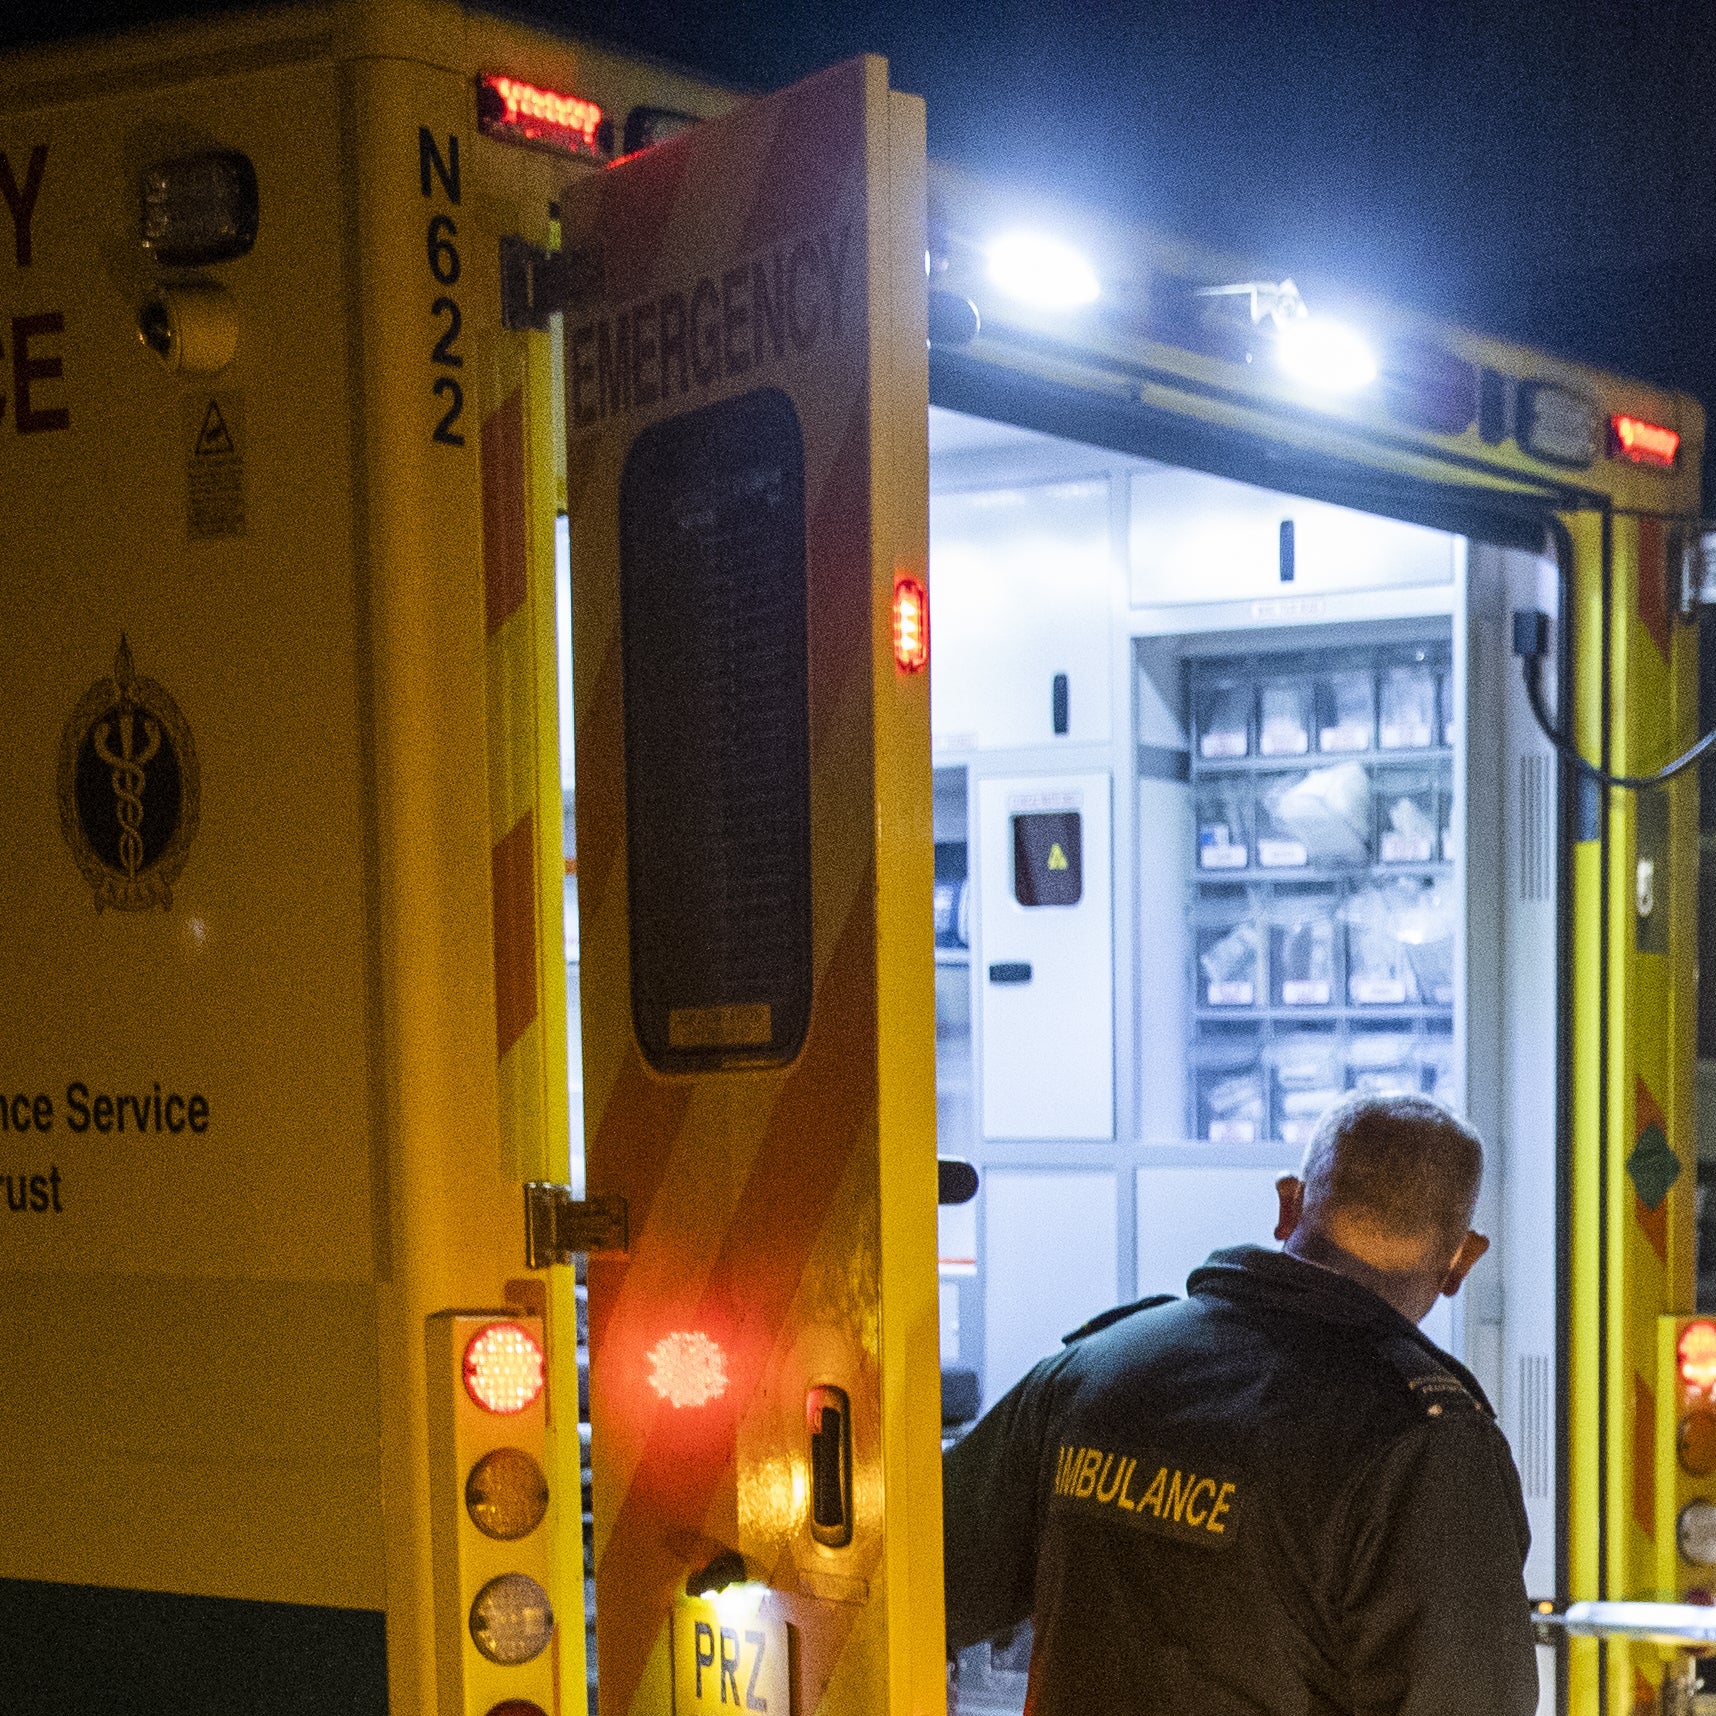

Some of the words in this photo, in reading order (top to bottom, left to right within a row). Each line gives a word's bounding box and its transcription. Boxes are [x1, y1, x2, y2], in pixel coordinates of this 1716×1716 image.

[418, 125, 467, 445] N622
[571, 226, 858, 428] EMERGENCY
[66, 1081, 210, 1134] Service
[694, 1620, 769, 1713] PRZ
